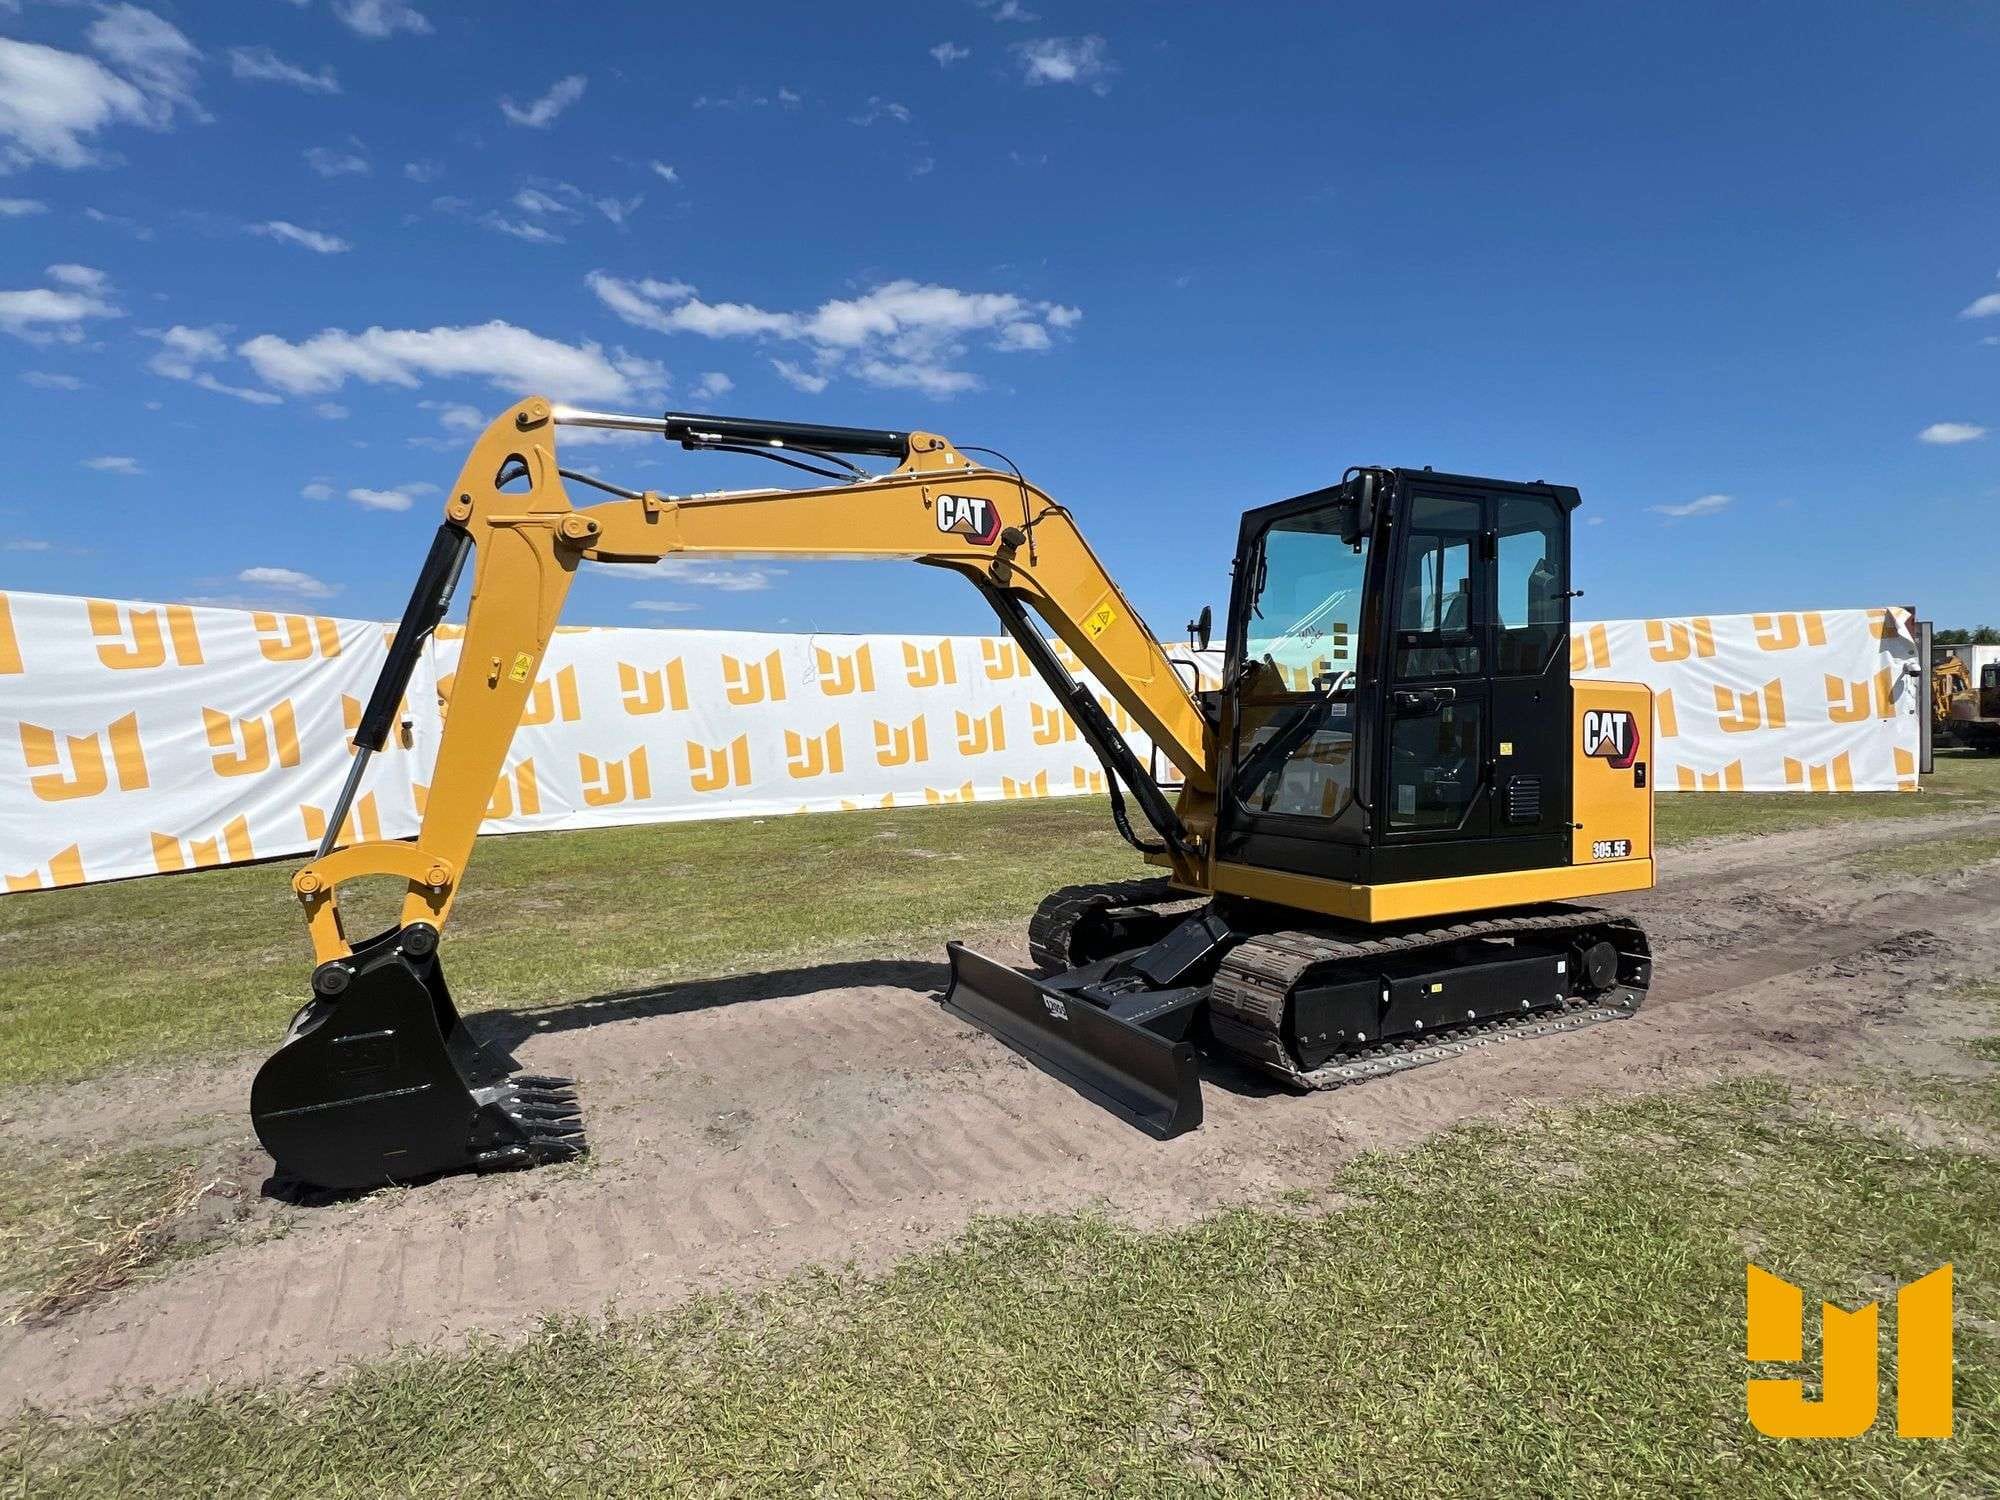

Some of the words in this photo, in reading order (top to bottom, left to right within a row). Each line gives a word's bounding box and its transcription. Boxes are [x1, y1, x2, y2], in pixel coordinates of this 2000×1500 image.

[937, 494, 987, 535] CAT
[1584, 711, 1627, 756] CAT
[1593, 840, 1627, 859] 305.5E
